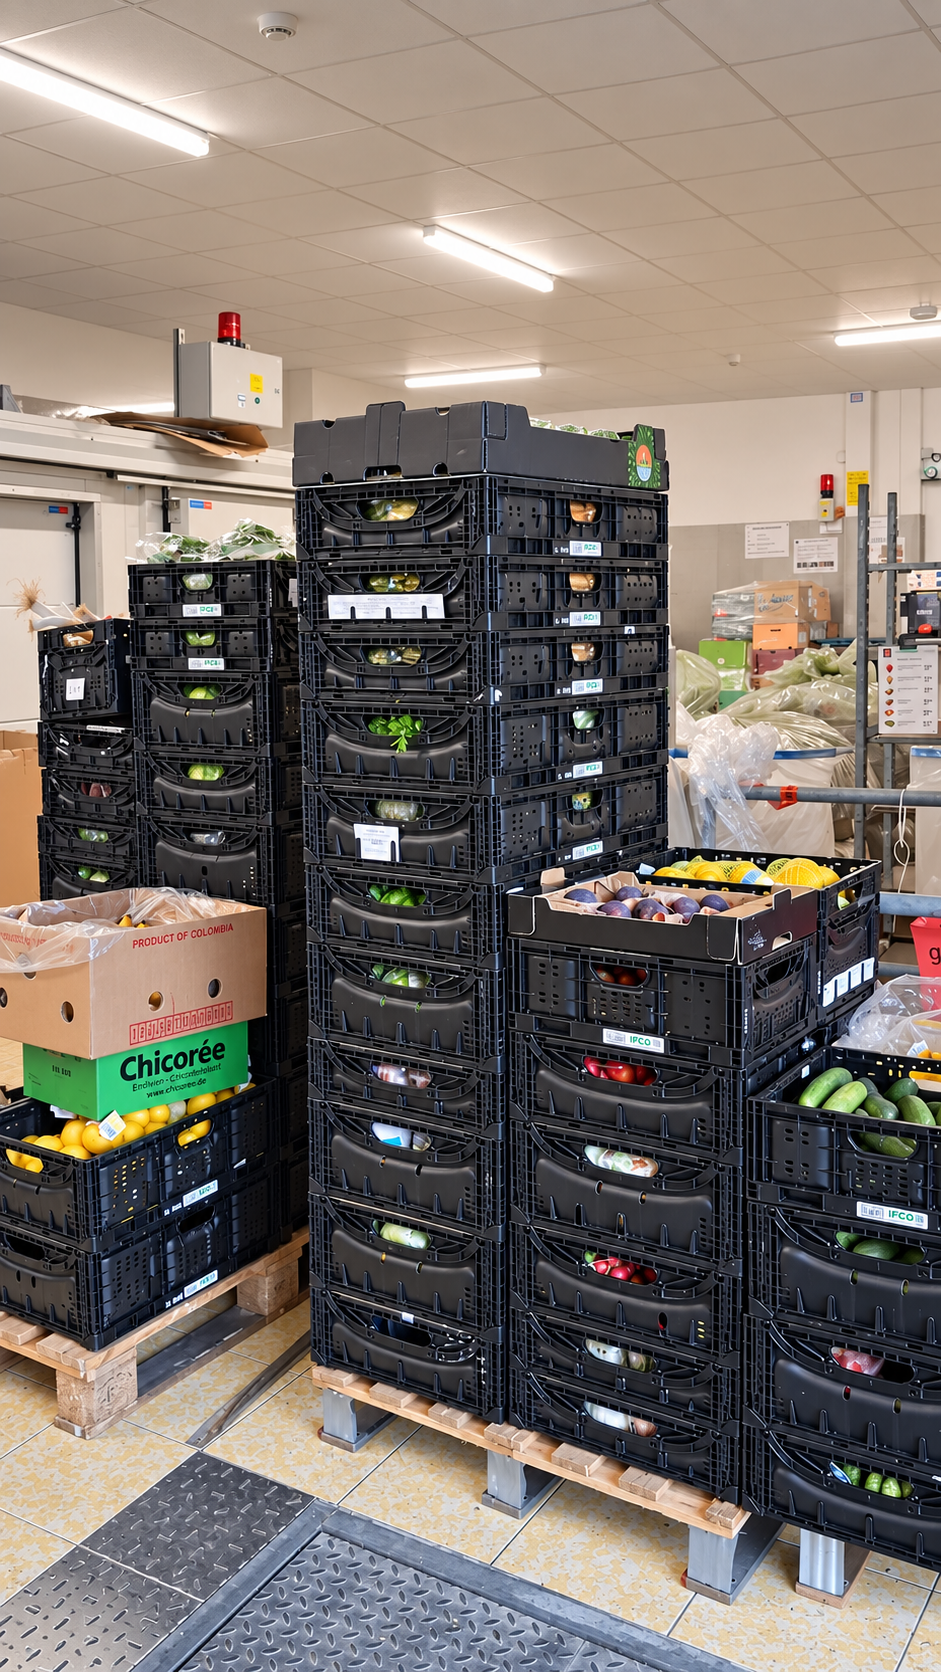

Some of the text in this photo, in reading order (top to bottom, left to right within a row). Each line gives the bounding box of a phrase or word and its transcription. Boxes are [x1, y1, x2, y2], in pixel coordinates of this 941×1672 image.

[132, 923, 234, 949] PRODUCT OF COLOMBIA
[120, 1039, 226, 1081] Chicorée
[888, 1209, 914, 1222] IFCO
